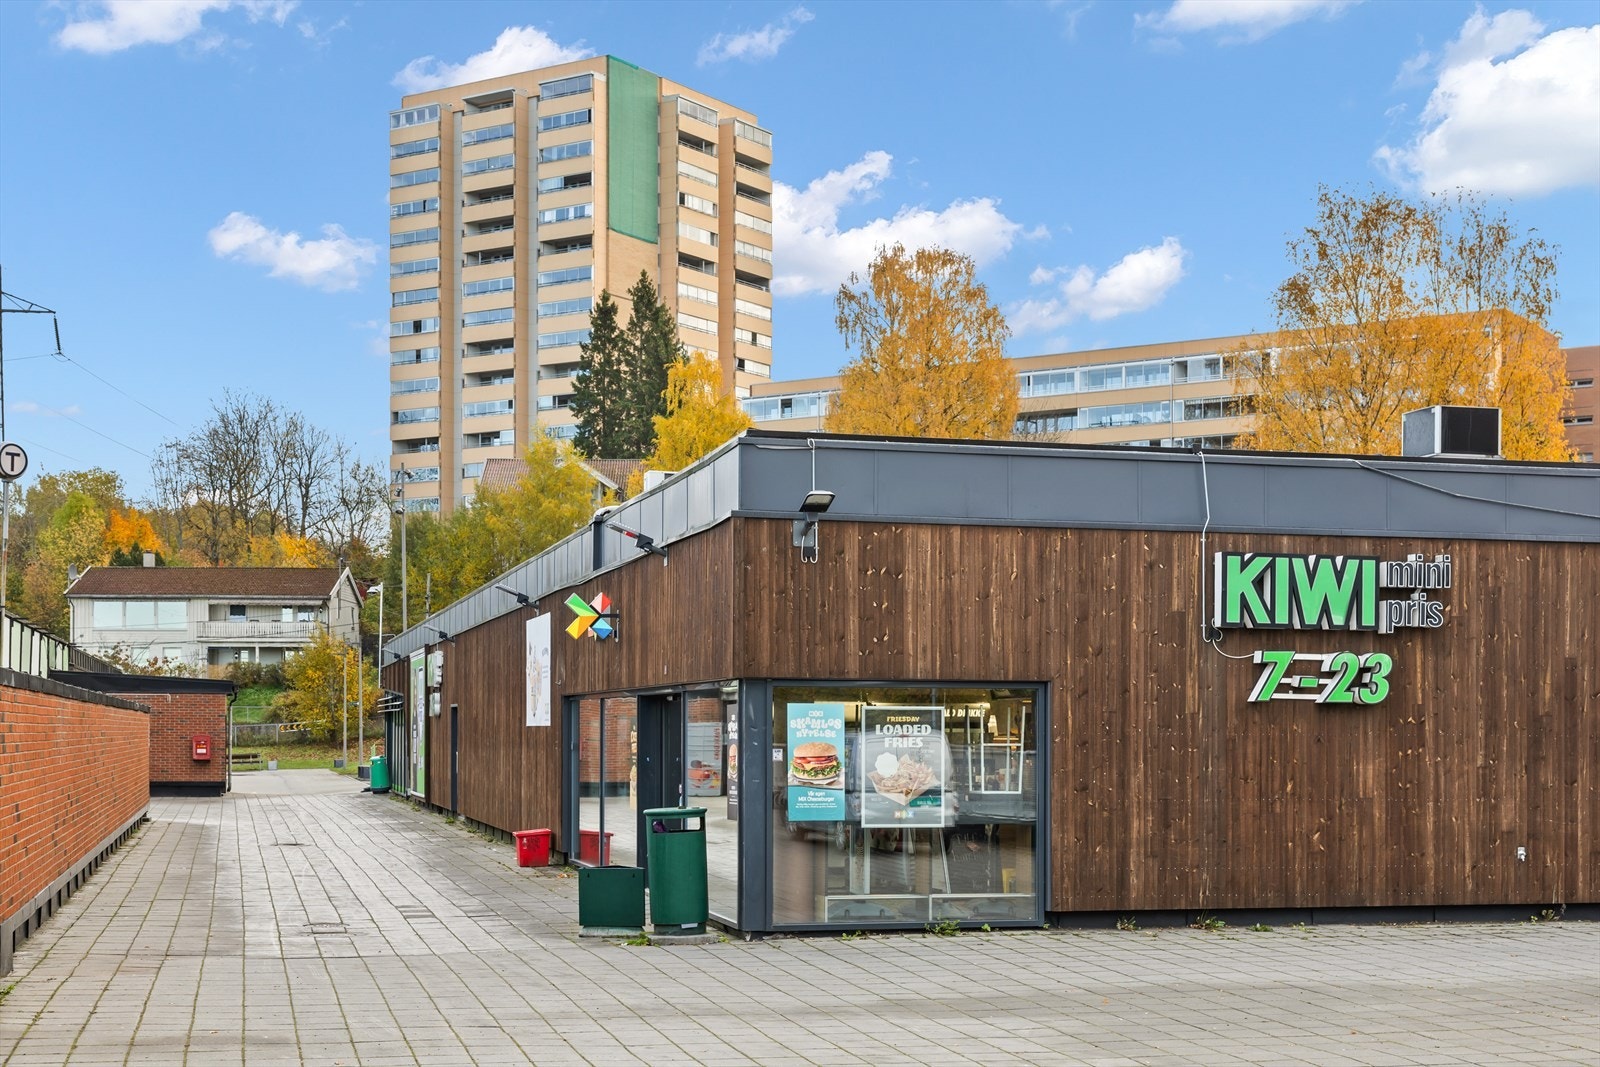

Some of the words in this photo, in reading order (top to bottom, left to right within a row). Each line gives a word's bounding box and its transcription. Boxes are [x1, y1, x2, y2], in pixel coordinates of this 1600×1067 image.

[5, 451, 21, 472] T
[1386, 554, 1452, 588] mini
[1222, 553, 1378, 629] KIWI
[1385, 592, 1444, 634] pris
[1252, 650, 1394, 704] 7-23
[875, 724, 932, 736] LOADED
[884, 737, 924, 748] FRIES
